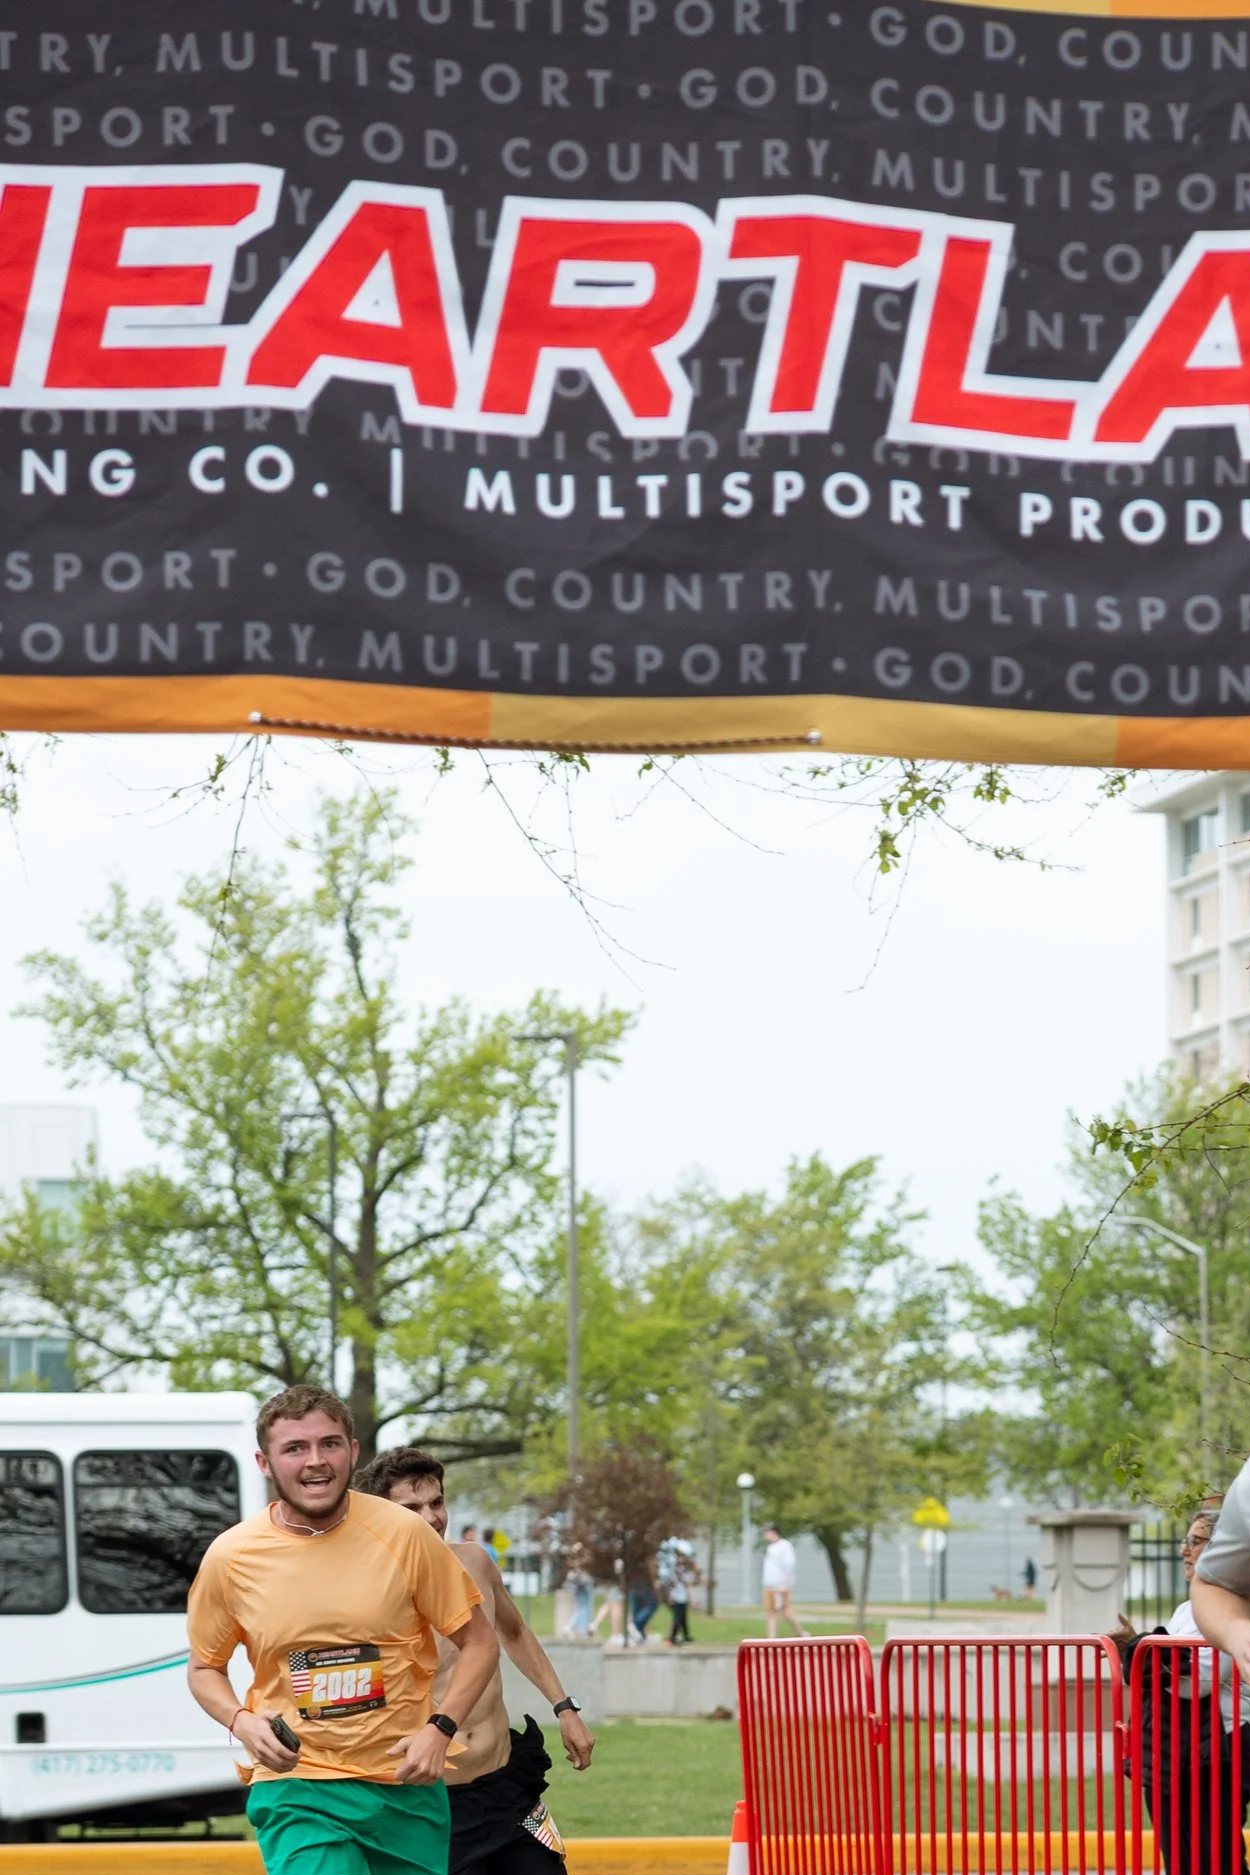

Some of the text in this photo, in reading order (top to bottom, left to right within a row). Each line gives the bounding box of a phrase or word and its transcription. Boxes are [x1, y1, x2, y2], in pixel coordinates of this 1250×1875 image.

[870, 7, 1025, 65] GOD,
[156, 31, 612, 108] MULTISPORT
[679, 65, 838, 109] GOD,
[870, 78, 1199, 144] COUNTRY,
[305, 115, 467, 175] GOD,
[502, 137, 838, 184] COUNTRY,
[187, 444, 330, 499] CO.
[462, 467, 972, 532] MULTISPORT
[307, 552, 470, 607] GOD,
[505, 568, 842, 613] COUNTRY,
[0, 622, 324, 667] OUNTRY,
[358, 631, 807, 684] MULTISPORT
[874, 648, 1033, 701] GOD,
[311, 1667, 372, 1703] 2082
